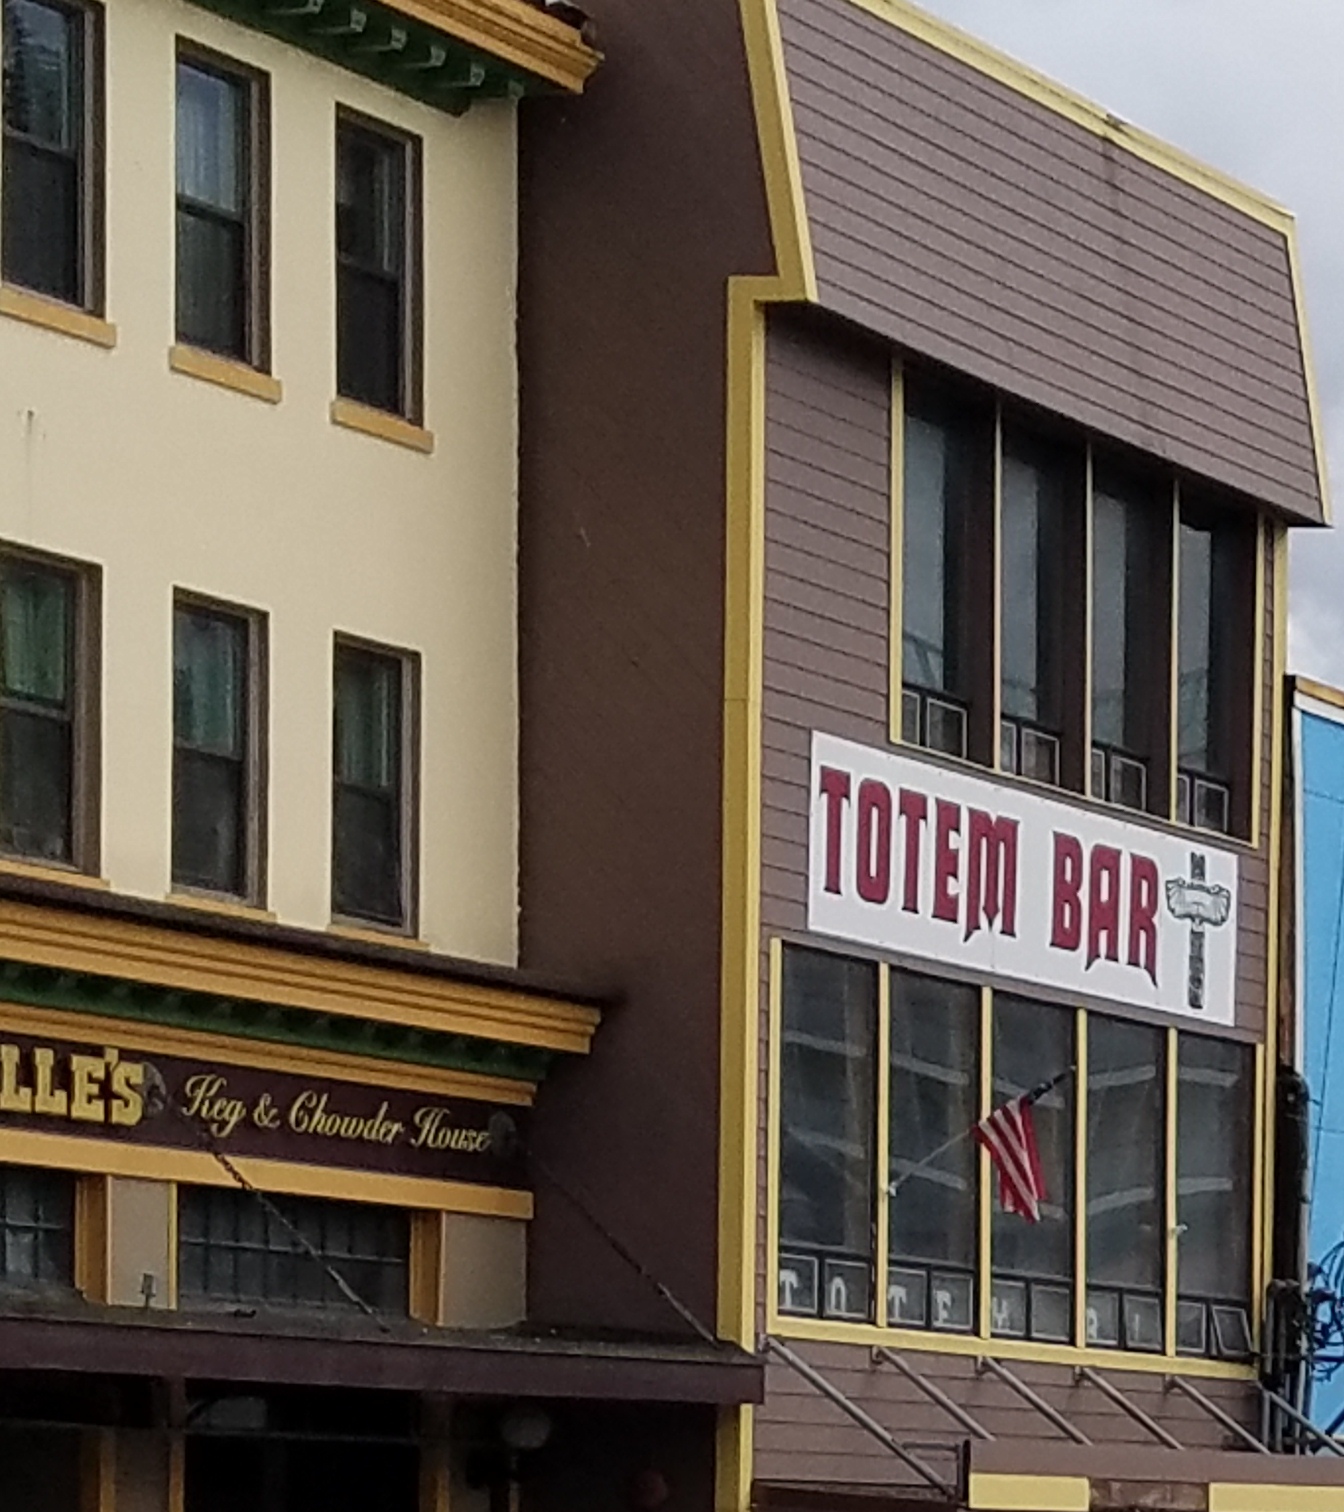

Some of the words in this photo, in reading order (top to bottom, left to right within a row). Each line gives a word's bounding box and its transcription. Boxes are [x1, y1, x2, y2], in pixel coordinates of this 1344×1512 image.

[818, 765, 1020, 942] TOTEM
[1050, 830, 1159, 987] BAR
[182, 1073, 247, 1138] Keg
[253, 1092, 281, 1129] &
[288, 1089, 405, 1143] Chowder
[410, 1105, 493, 1152] House
